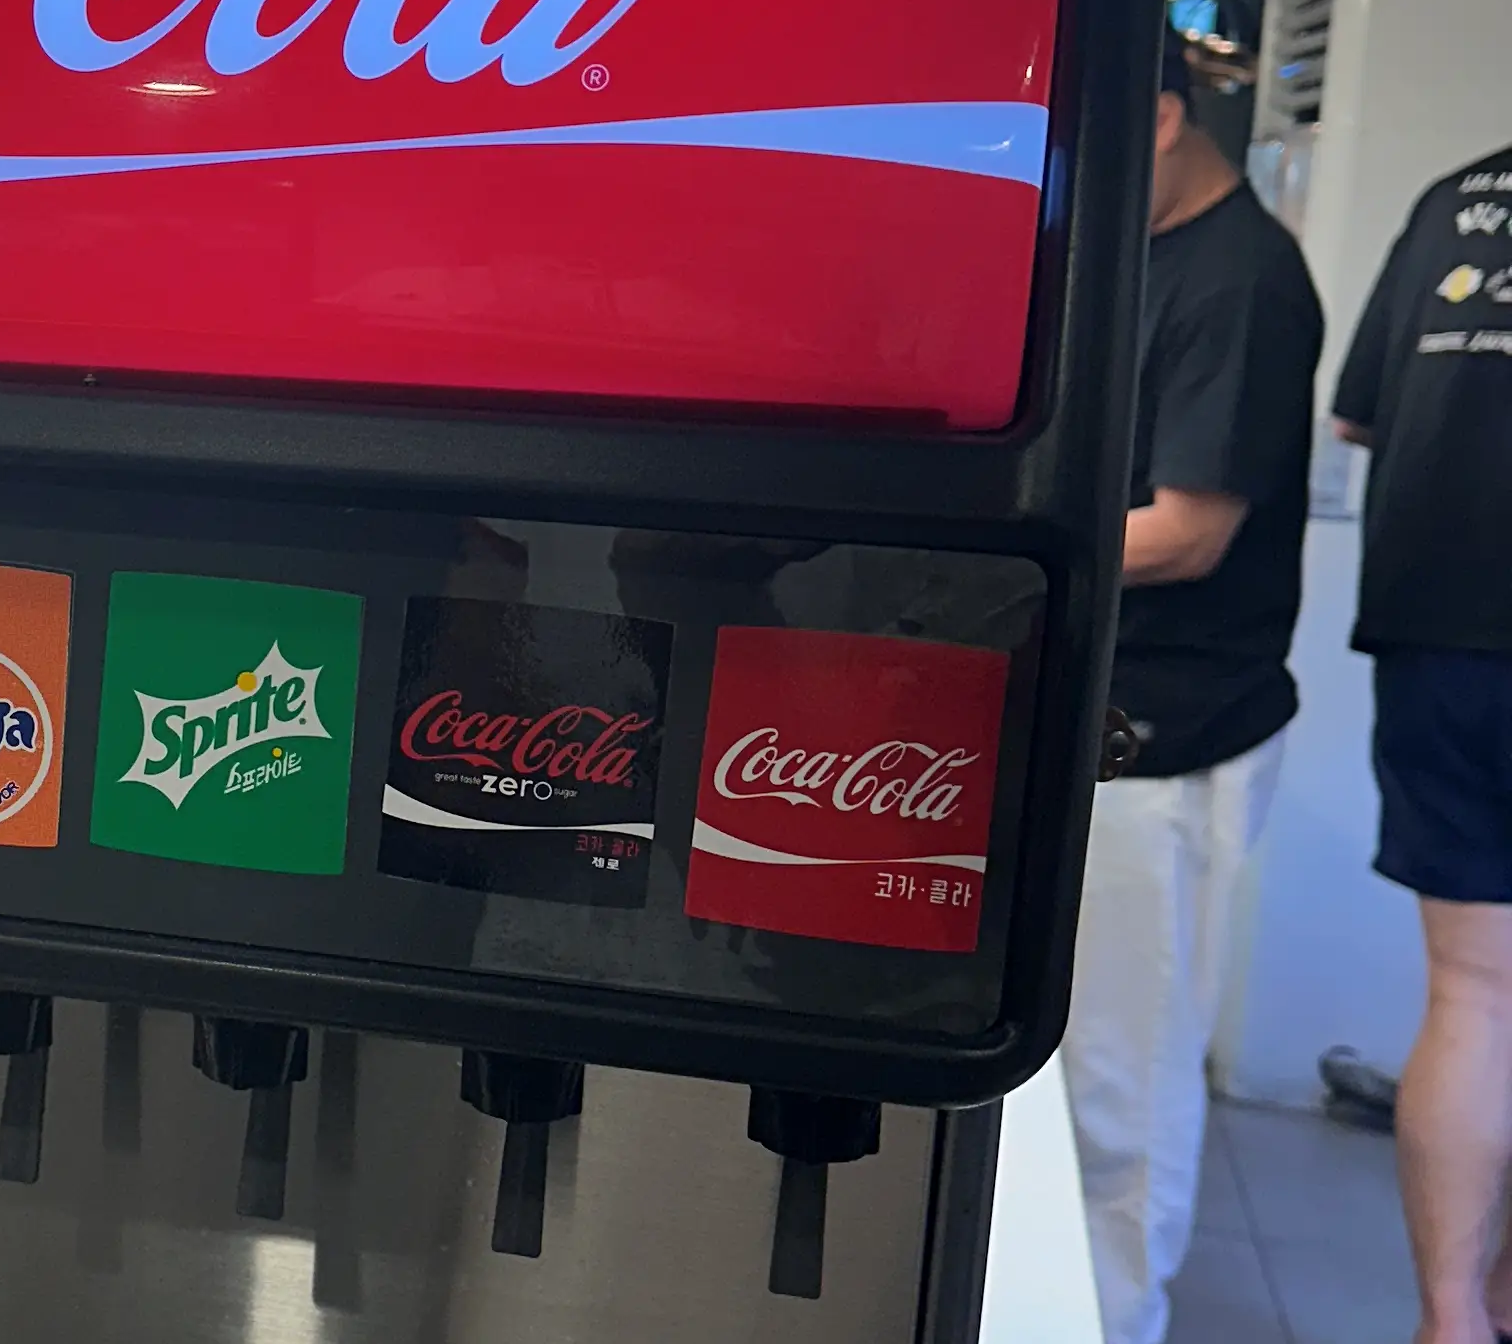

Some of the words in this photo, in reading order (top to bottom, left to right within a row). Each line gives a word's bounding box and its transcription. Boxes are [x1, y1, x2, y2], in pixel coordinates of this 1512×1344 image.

[143, 671, 307, 780] Sprite
[399, 689, 655, 786] Coca-Cola
[224, 748, 302, 794] 스프라이트
[481, 774, 552, 801] zero
[714, 727, 980, 821] Coca-Cola
[591, 856, 620, 871] 제로
